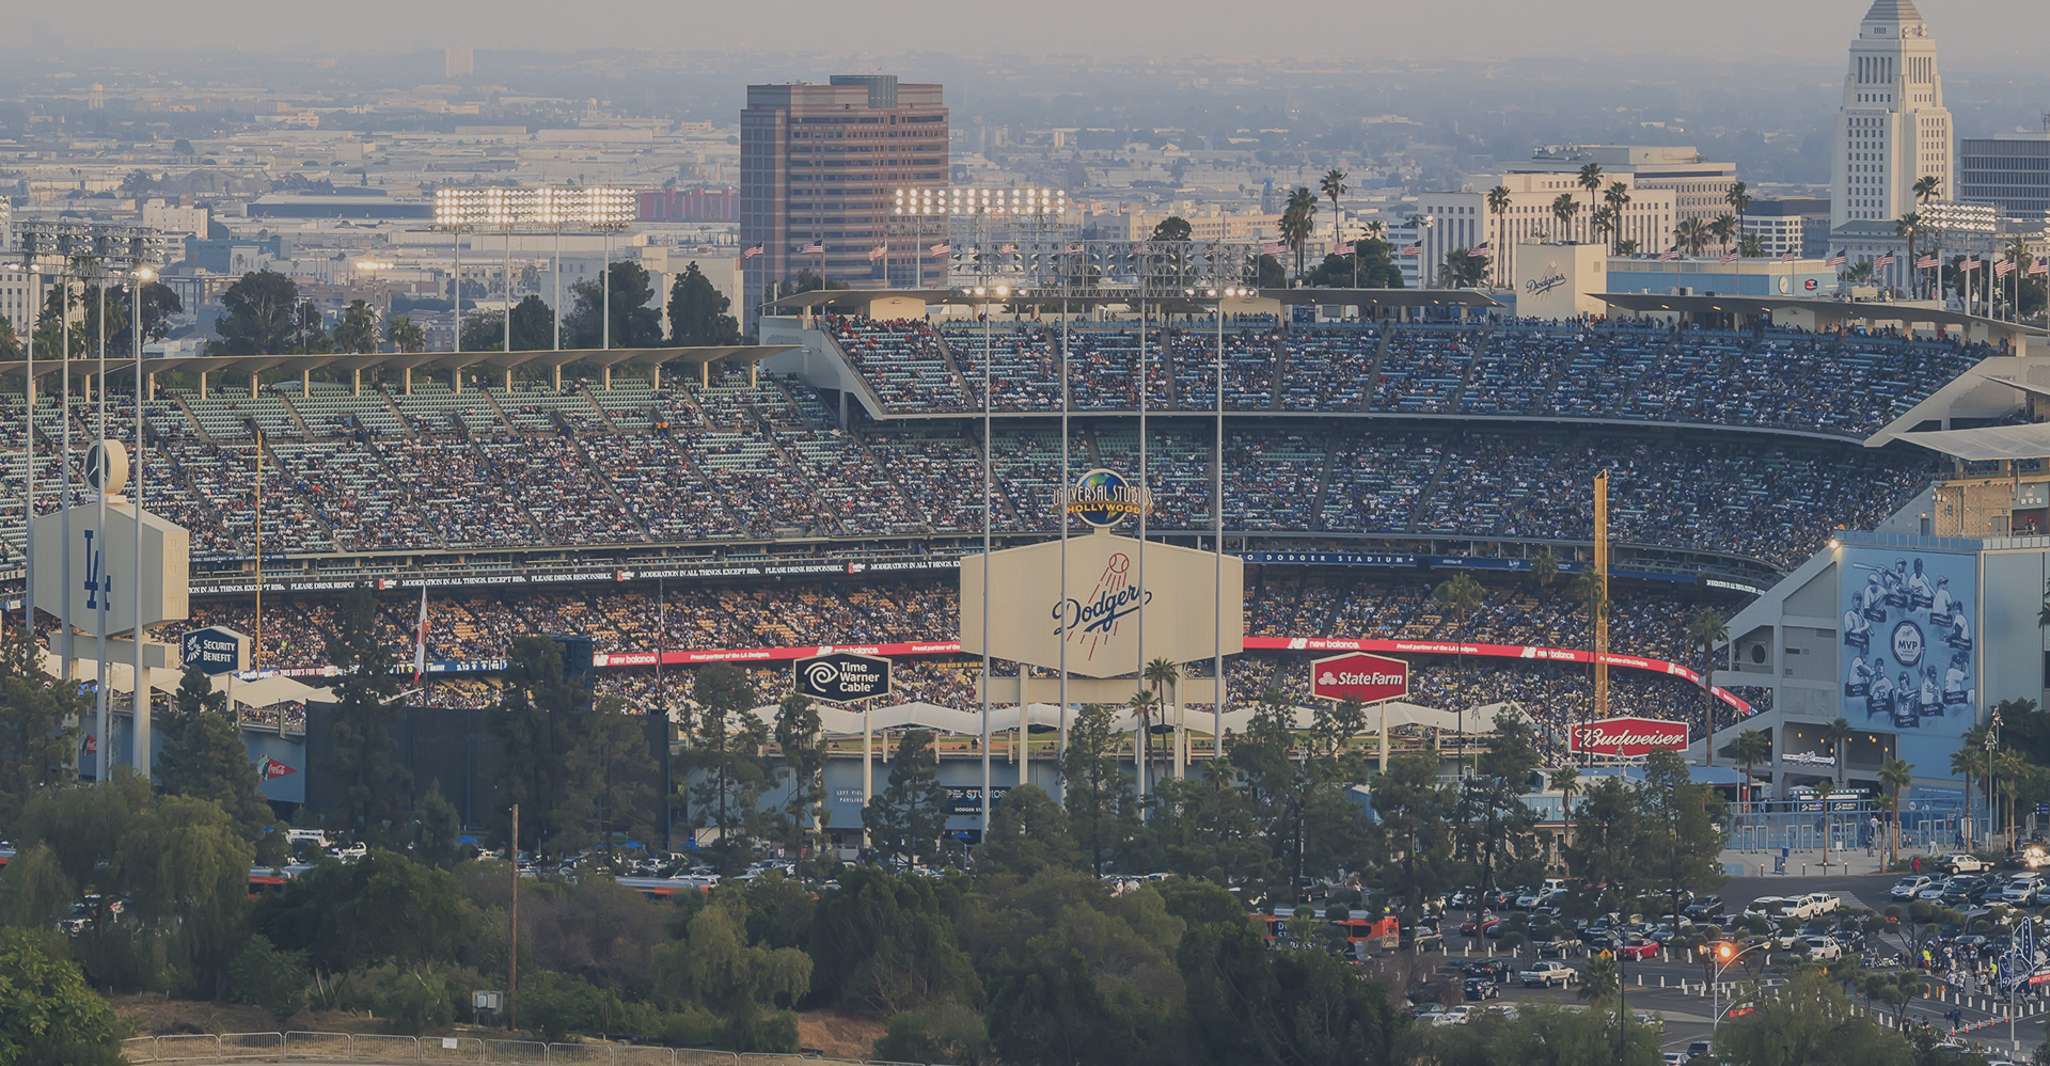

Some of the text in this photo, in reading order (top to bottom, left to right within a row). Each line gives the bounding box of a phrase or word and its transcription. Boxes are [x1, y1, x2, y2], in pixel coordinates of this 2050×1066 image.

[1526, 272, 1567, 295] Dodgers
[1067, 503, 1141, 513] HOLLYWOOD
[1338, 555, 1403, 563] STADIUM
[765, 566, 786, 574] PLEASE
[787, 565, 805, 573] DRINK
[871, 562, 908, 570] MODERATION
[487, 576, 511, 584] EXCEPT
[290, 582, 313, 590] PLEASE
[203, 639, 236, 651] SECURITY
[1309, 640, 1326, 648] new
[1897, 640, 1918, 650] MVP
[203, 651, 232, 663] BENEFIT
[609, 656, 626, 665] new
[840, 661, 868, 673] Time
[840, 673, 880, 683] Warner
[840, 682, 872, 692] Cable
[1574, 728, 1684, 748] Budweiser
[966, 789, 1009, 799] STUIOS
